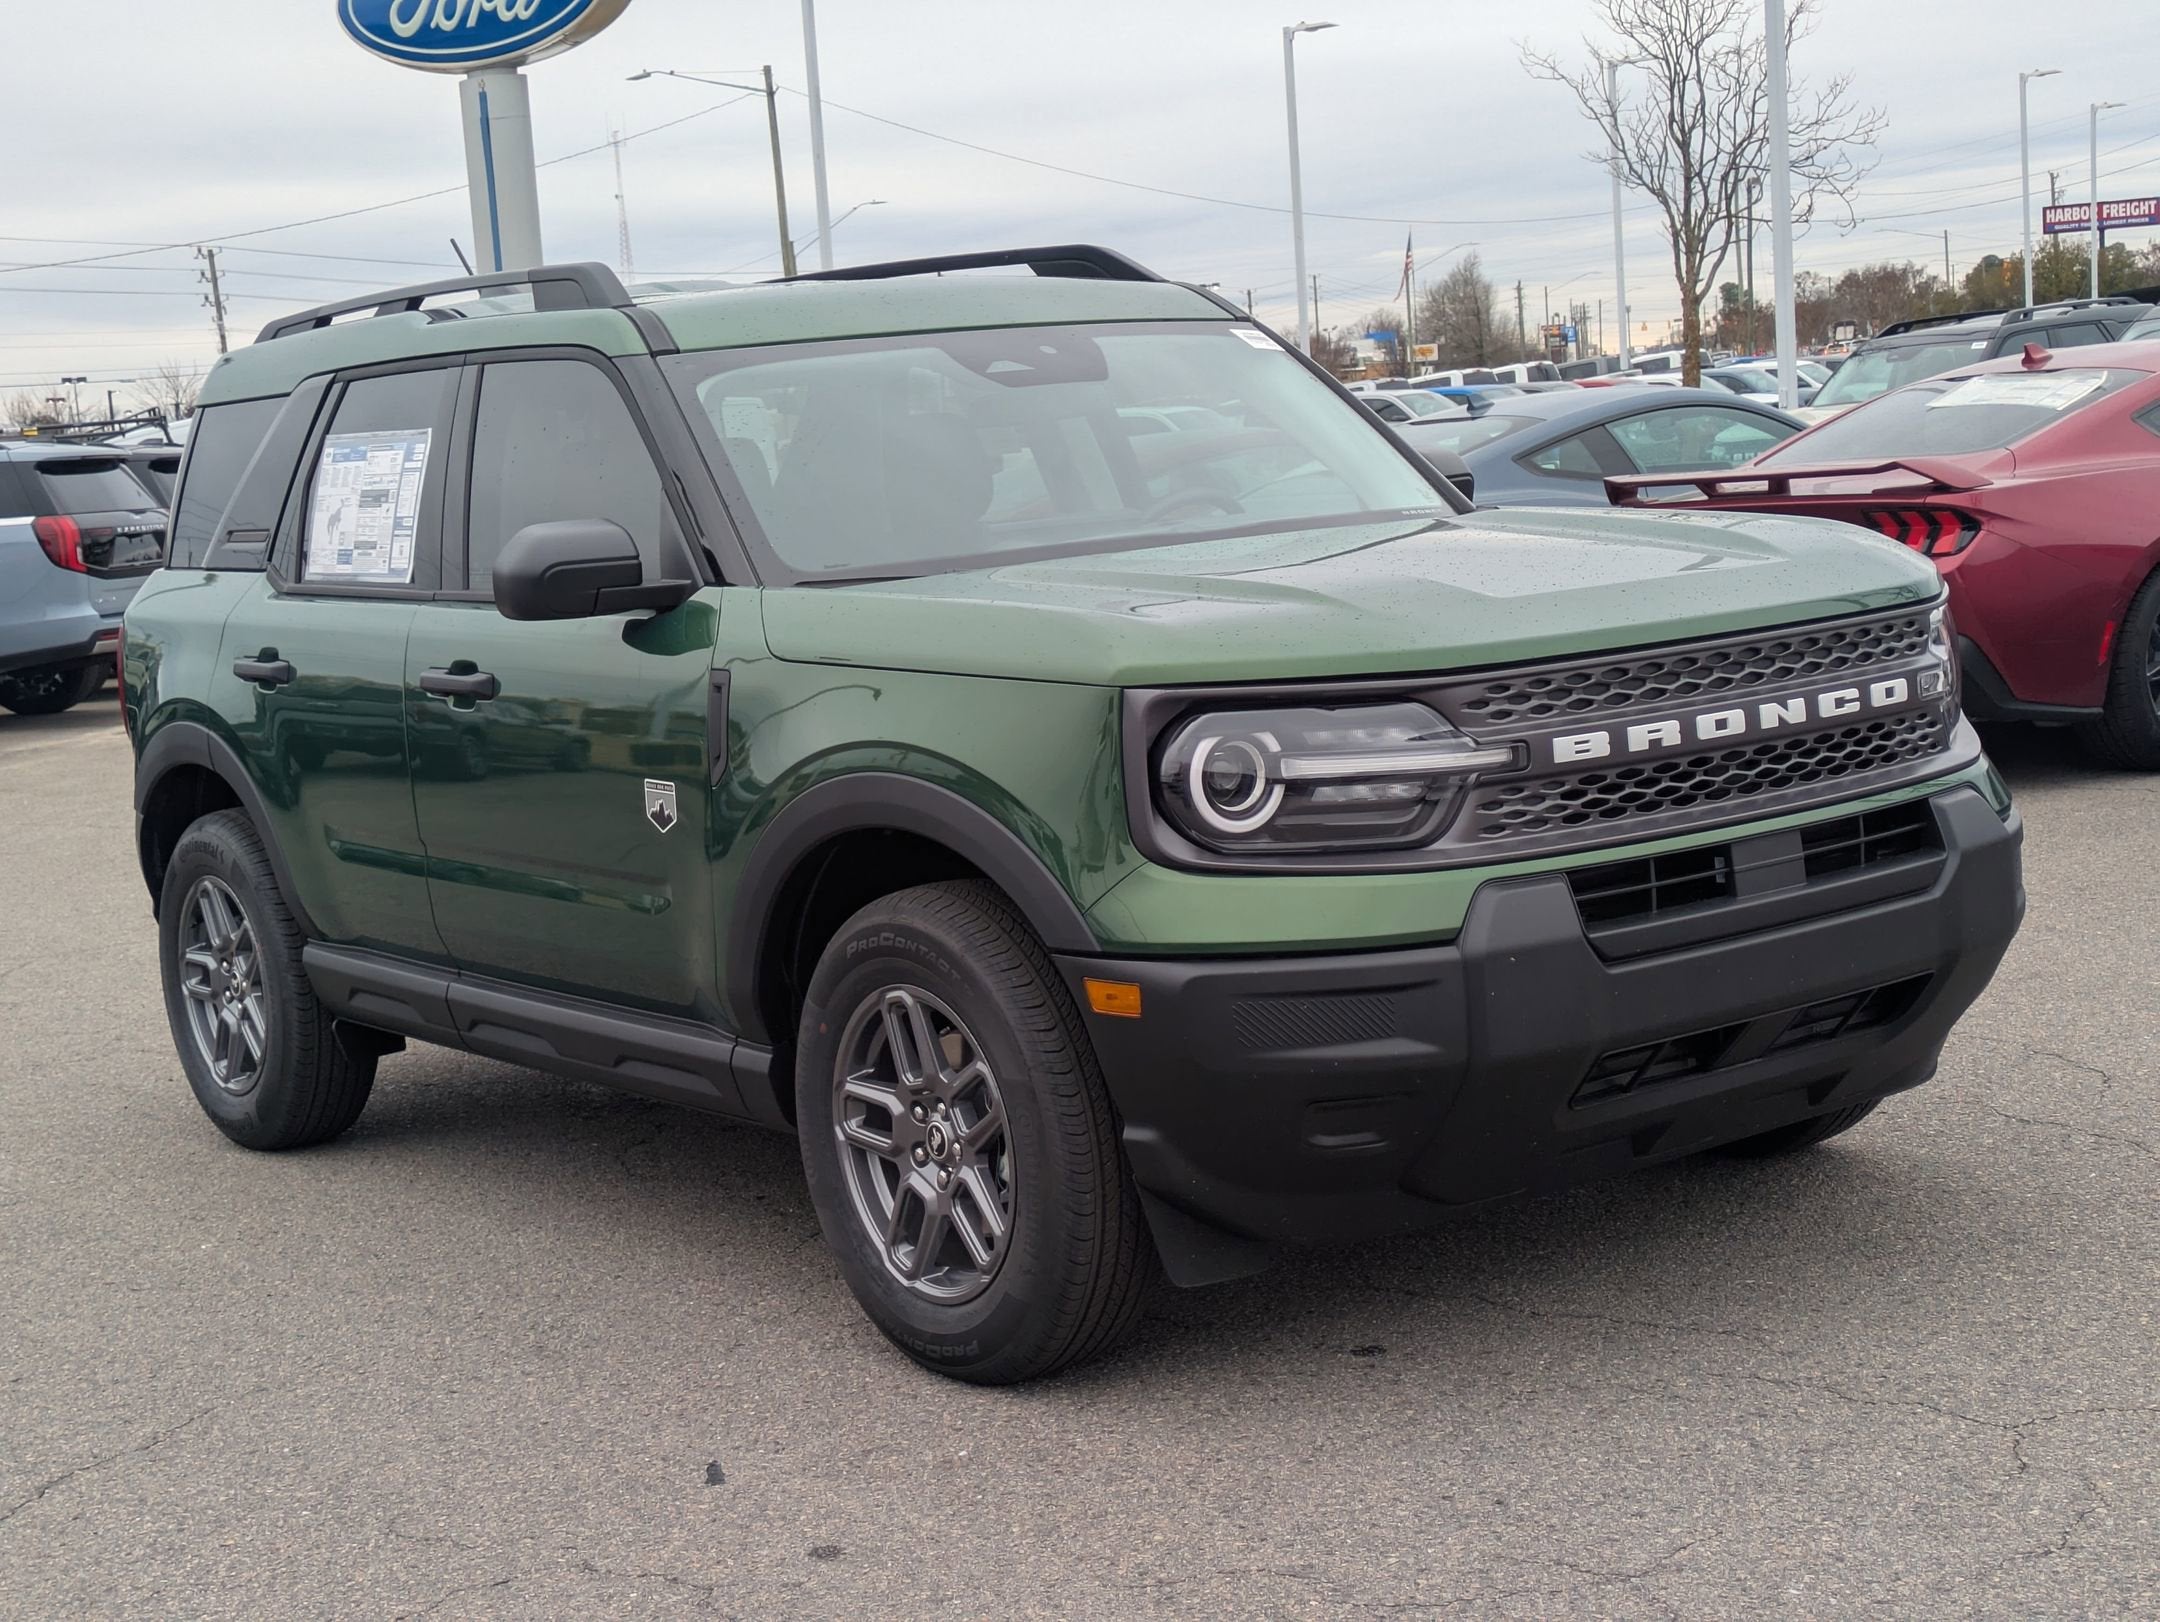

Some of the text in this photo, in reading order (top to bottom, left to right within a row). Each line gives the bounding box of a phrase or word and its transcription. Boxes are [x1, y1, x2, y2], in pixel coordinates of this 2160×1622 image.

[2046, 200, 2157, 223] HARBO FREIGHT
[1552, 677, 1909, 764] BRONCO
